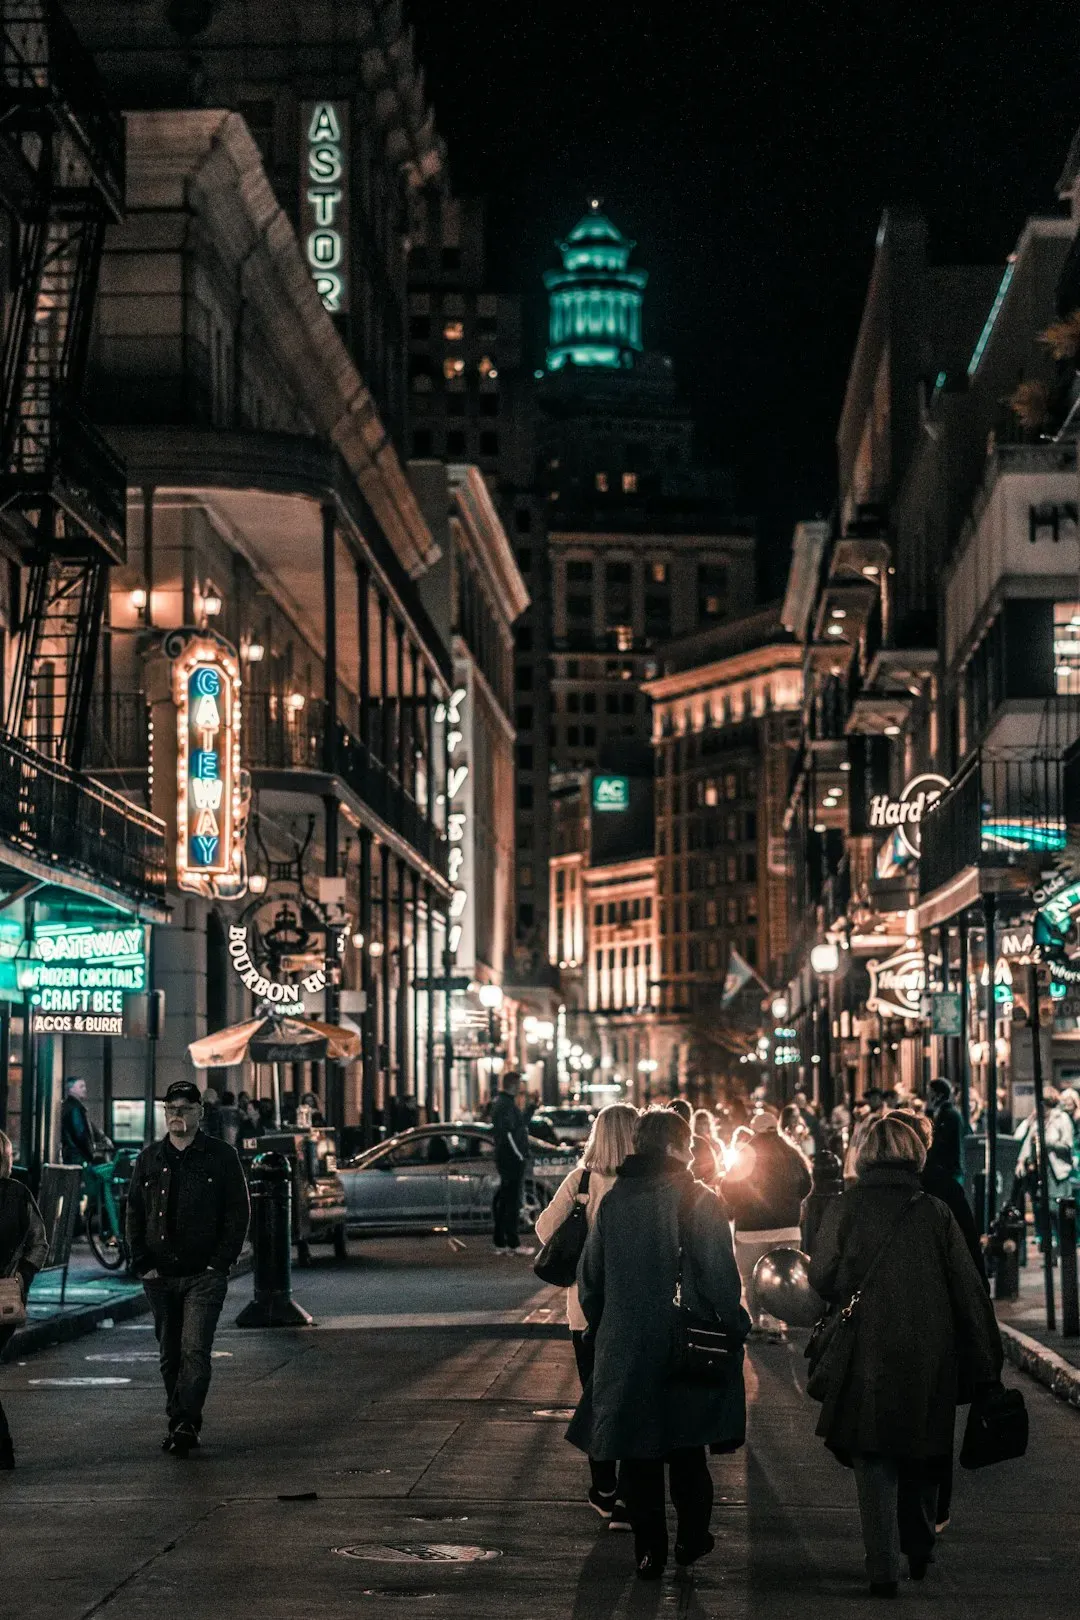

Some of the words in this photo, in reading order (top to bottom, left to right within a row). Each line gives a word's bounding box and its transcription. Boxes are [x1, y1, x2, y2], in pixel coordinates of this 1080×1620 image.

[308, 103, 342, 312] ASTOR
[192, 667, 223, 864] GATEWAY
[870, 792, 925, 826] Hard
[38, 928, 142, 961] GATEWAY
[79, 966, 144, 988] COCKTAILS
[228, 924, 300, 1002] BOURBON
[41, 989, 90, 1012] CRAFT
[34, 1016, 72, 1031] ACOS
